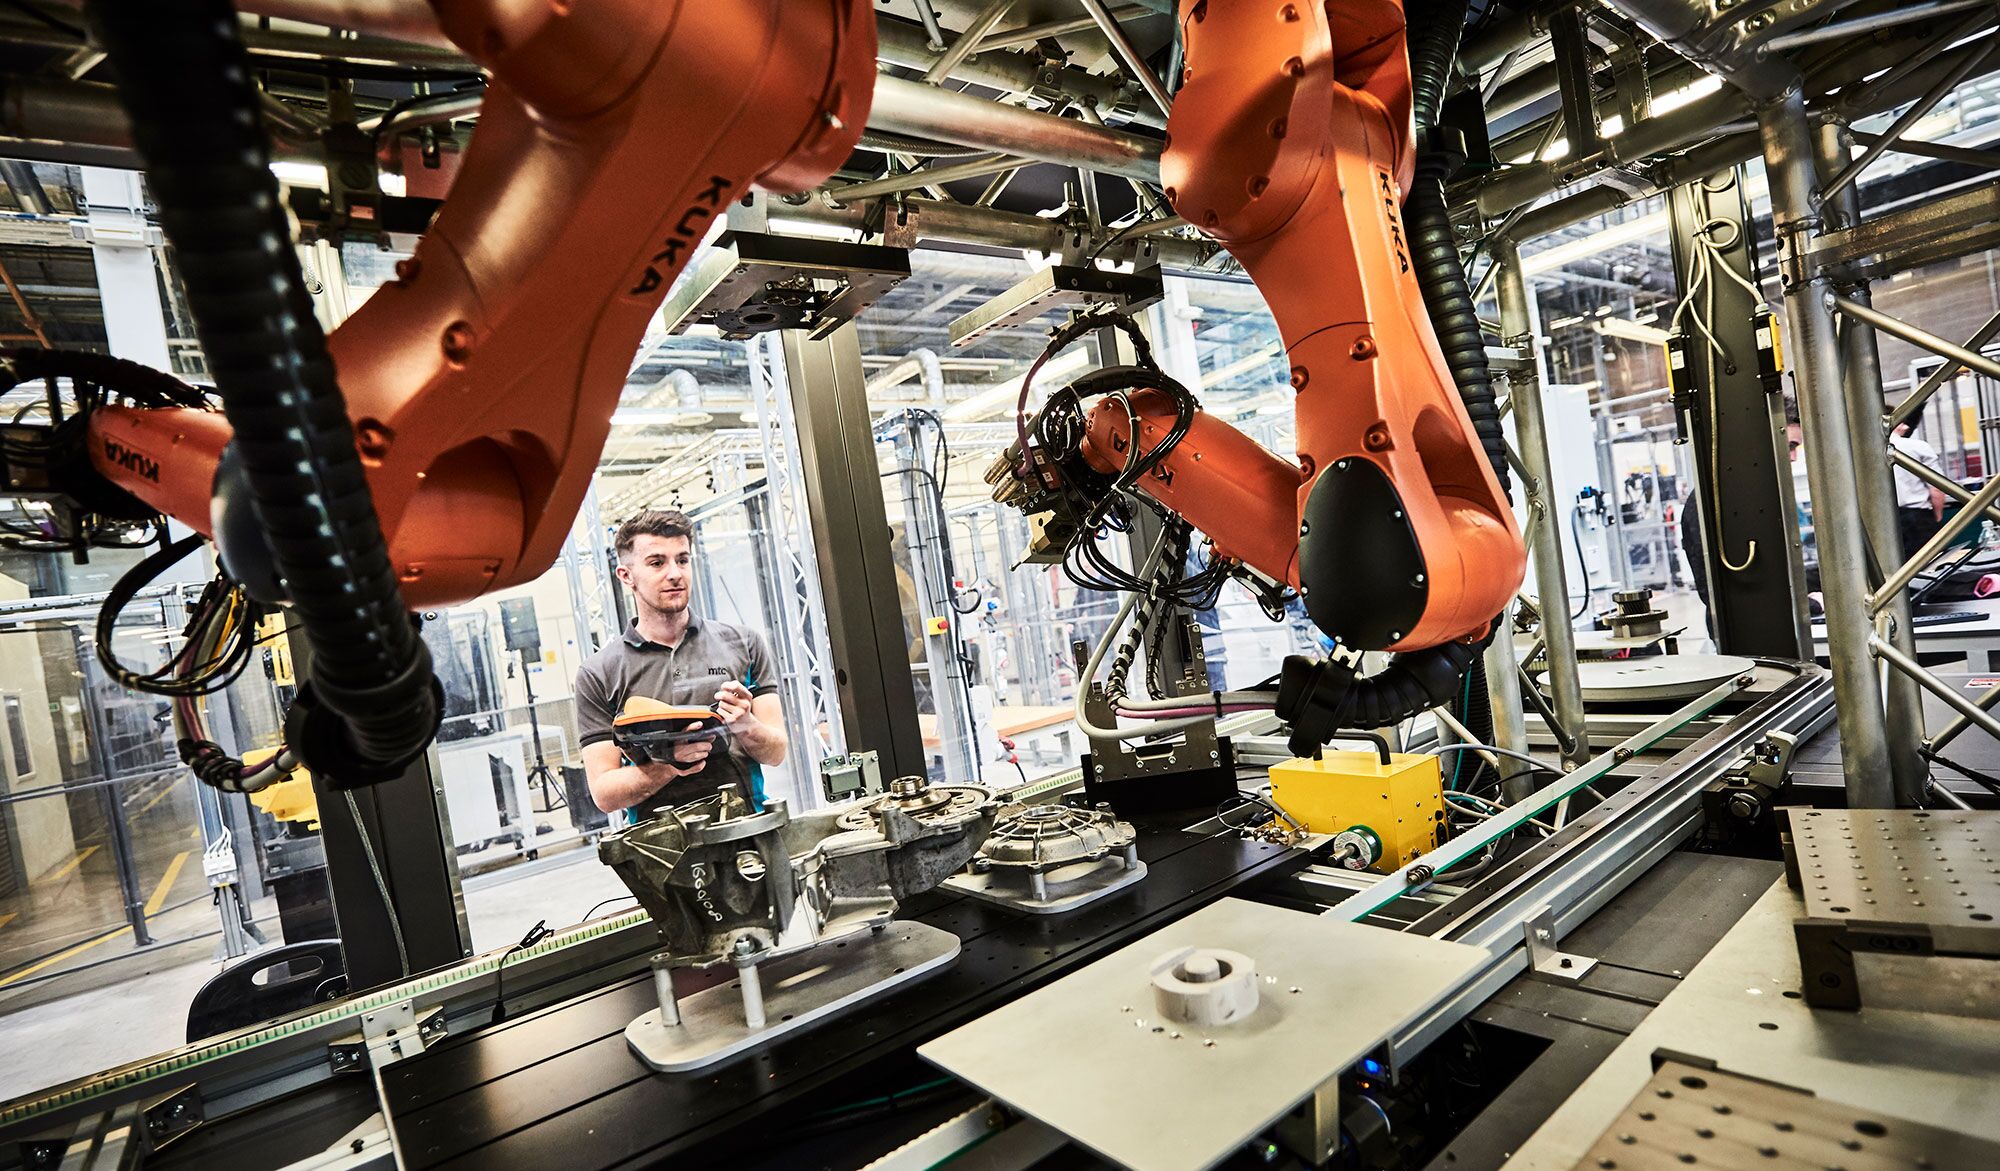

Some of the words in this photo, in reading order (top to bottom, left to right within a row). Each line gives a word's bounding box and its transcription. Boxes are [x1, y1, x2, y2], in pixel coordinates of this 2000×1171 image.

[631, 176, 731, 294] KUKA
[1380, 172, 1408, 274] KUKA
[104, 438, 159, 483] KUKA
[1113, 432, 1174, 486] KA
[708, 667, 726, 675] mtc
